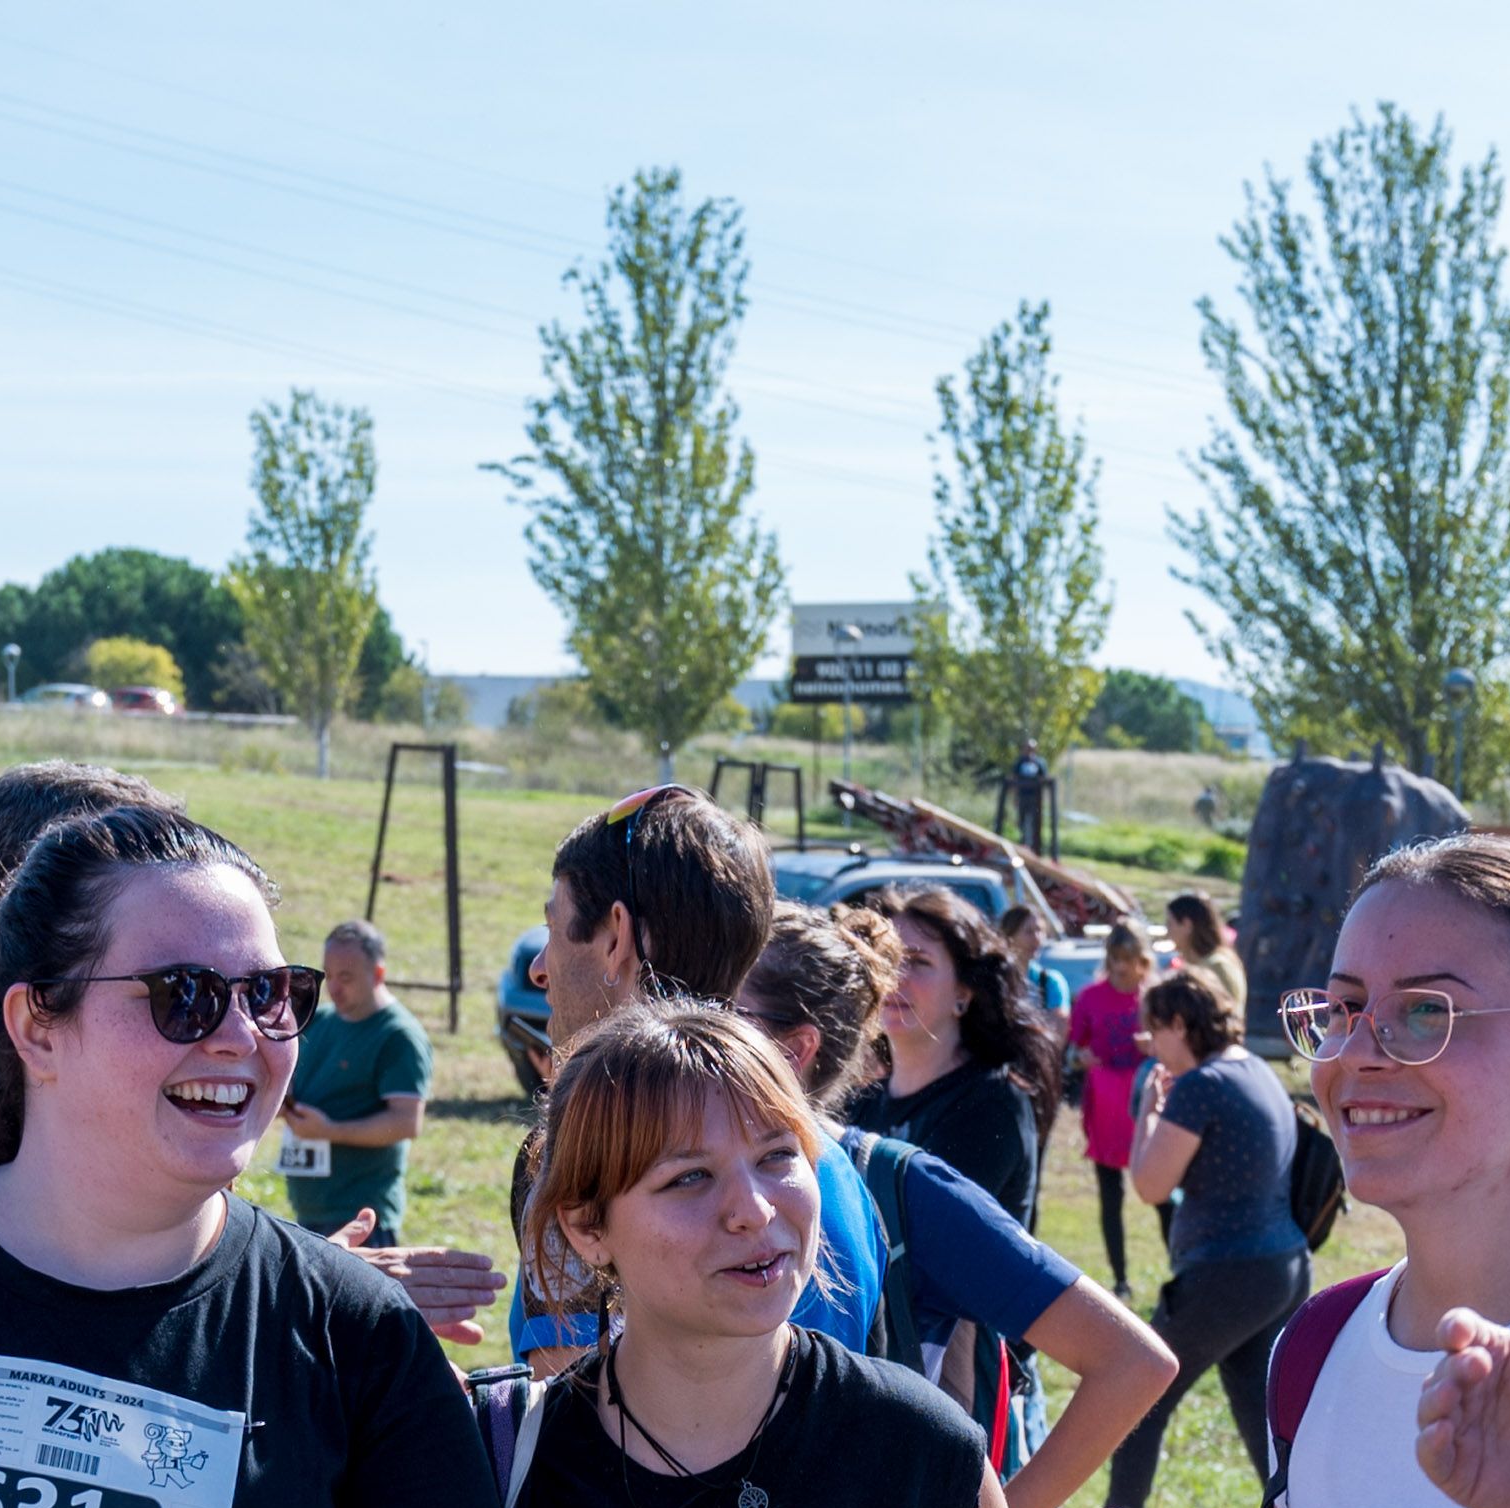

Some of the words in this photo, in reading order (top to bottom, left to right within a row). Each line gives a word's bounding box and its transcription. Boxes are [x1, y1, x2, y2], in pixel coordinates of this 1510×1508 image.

[9, 1370, 55, 1386] MARXA
[58, 1379, 106, 1399] ADULTS
[115, 1394, 144, 1408] 2024
[44, 1396, 95, 1435] 75
